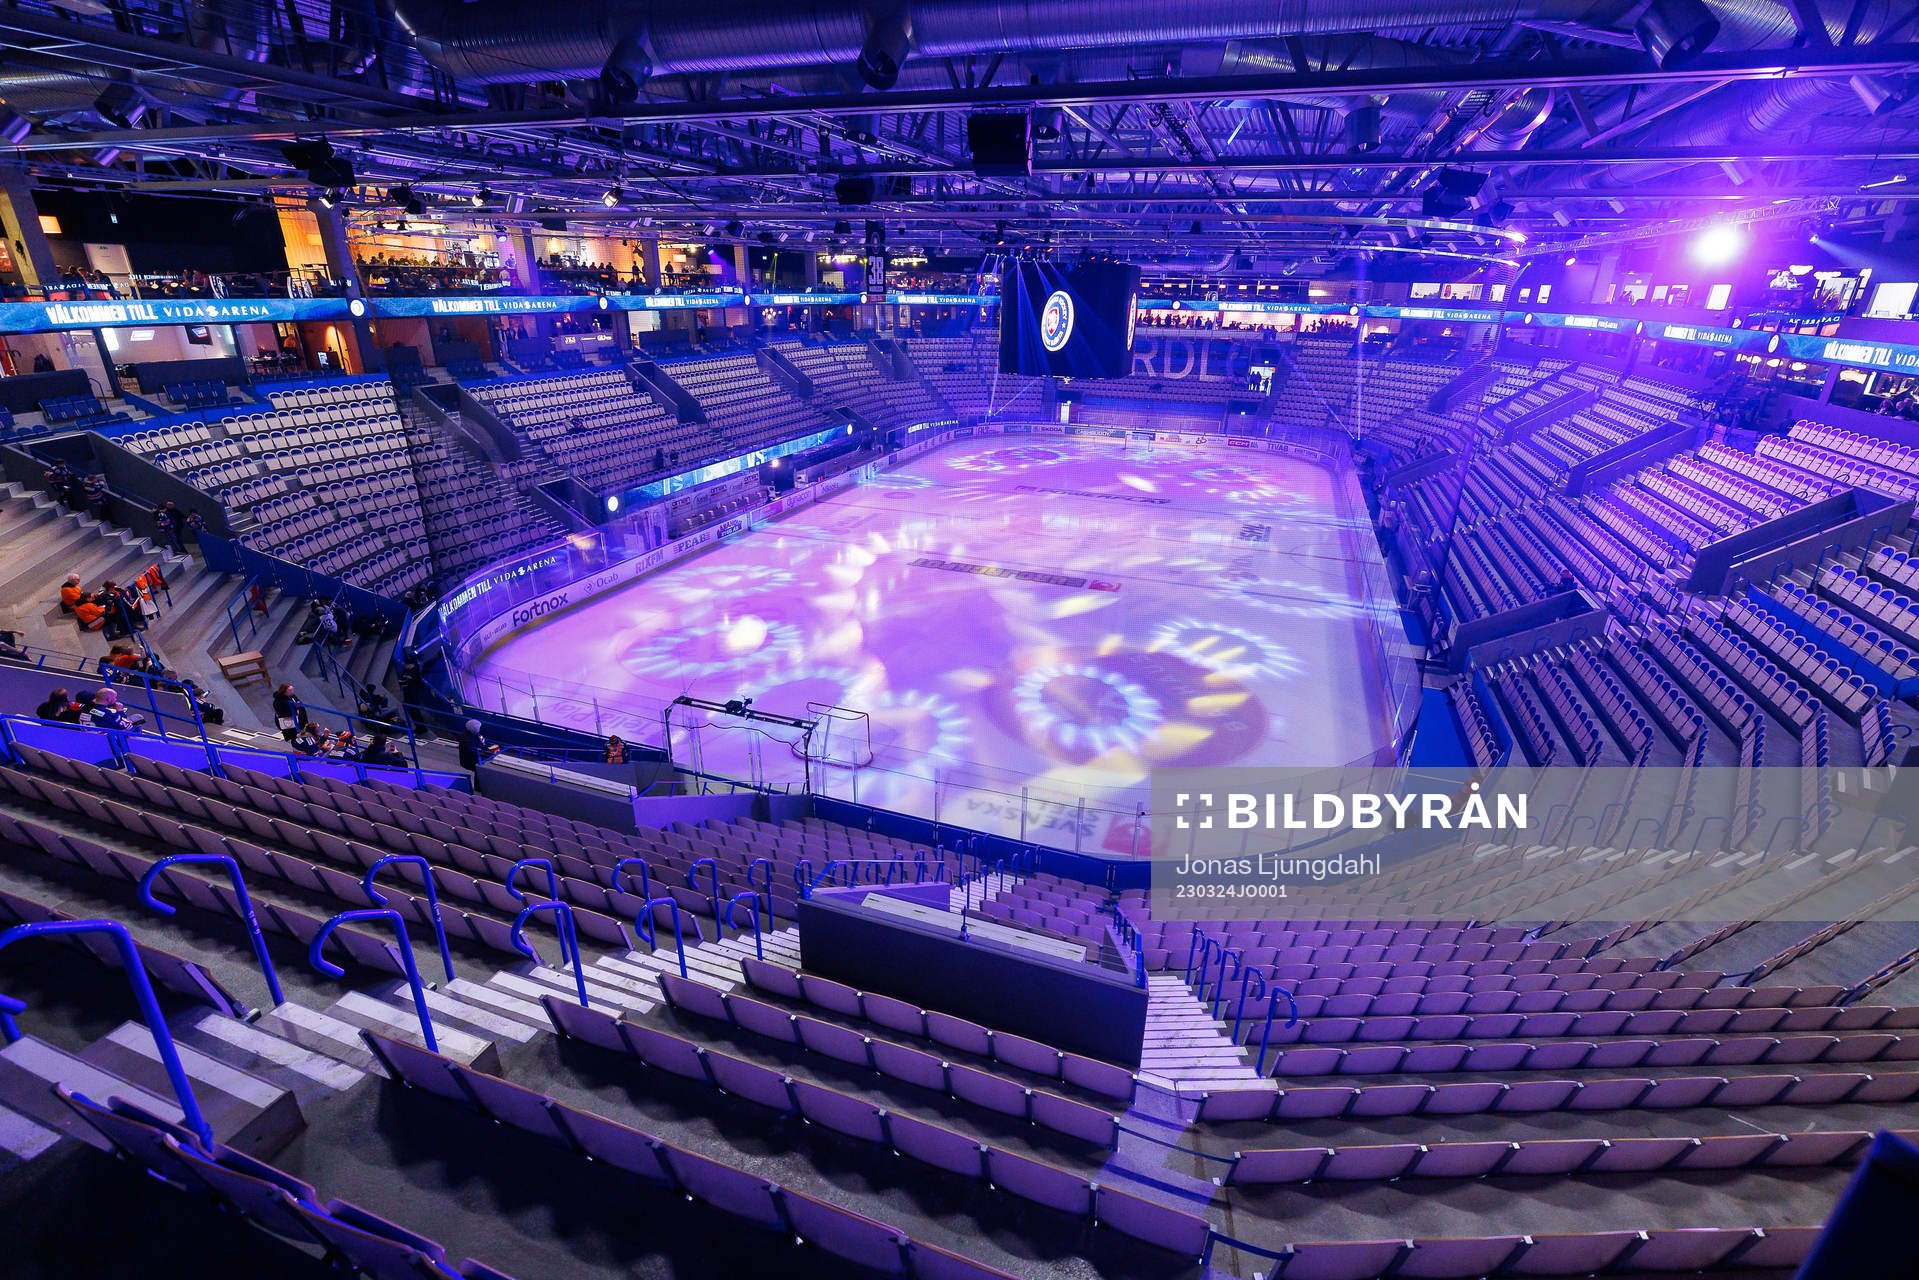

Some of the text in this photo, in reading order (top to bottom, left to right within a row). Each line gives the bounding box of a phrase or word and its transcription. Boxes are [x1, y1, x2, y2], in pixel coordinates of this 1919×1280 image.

[46, 304, 269, 324] VÄLKOMMEN TILL VIDA ARENA
[432, 300, 484, 312] VÄLKOMMEN
[484, 300, 500, 311] TILL
[1823, 340, 1874, 364] VÄLKOMMEN
[1872, 348, 1893, 366] TILL
[476, 579, 492, 596] TILL
[494, 570, 517, 584] VIDA
[526, 556, 556, 572] ARENA
[596, 572, 619, 588] Ocab
[512, 592, 569, 628] Fortnox
